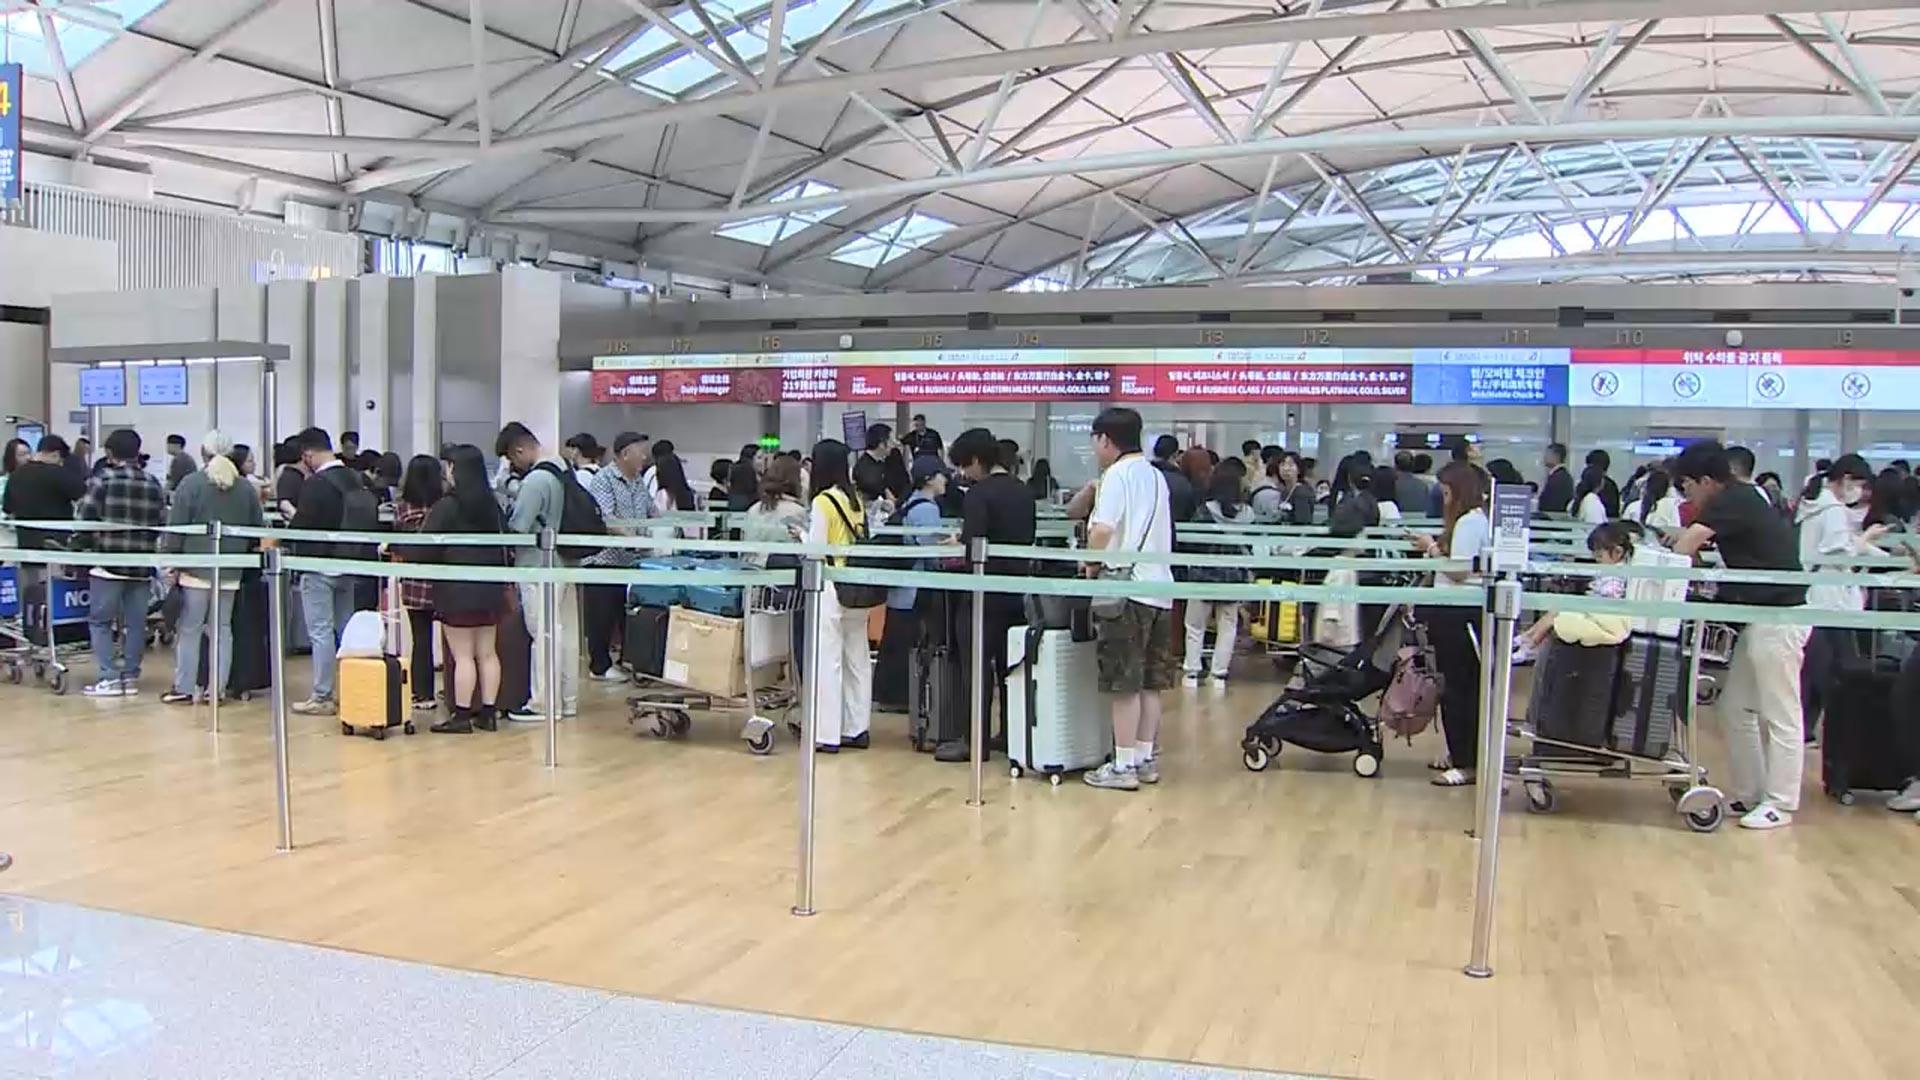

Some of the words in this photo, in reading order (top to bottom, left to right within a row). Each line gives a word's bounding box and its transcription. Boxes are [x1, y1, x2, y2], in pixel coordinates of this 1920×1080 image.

[1197, 329, 1225, 345] J13
[1302, 329, 1330, 345] J12
[1616, 330, 1644, 345] J10
[609, 386, 626, 396] Duty
[627, 386, 657, 396] Manager
[680, 385, 698, 395] Duty
[699, 385, 730, 396] Manager
[925, 385, 955, 393] BUSINESS
[957, 385, 976, 393] CLASS
[1203, 386, 1236, 394] BUSINESS
[1238, 386, 1260, 394] CLASS
